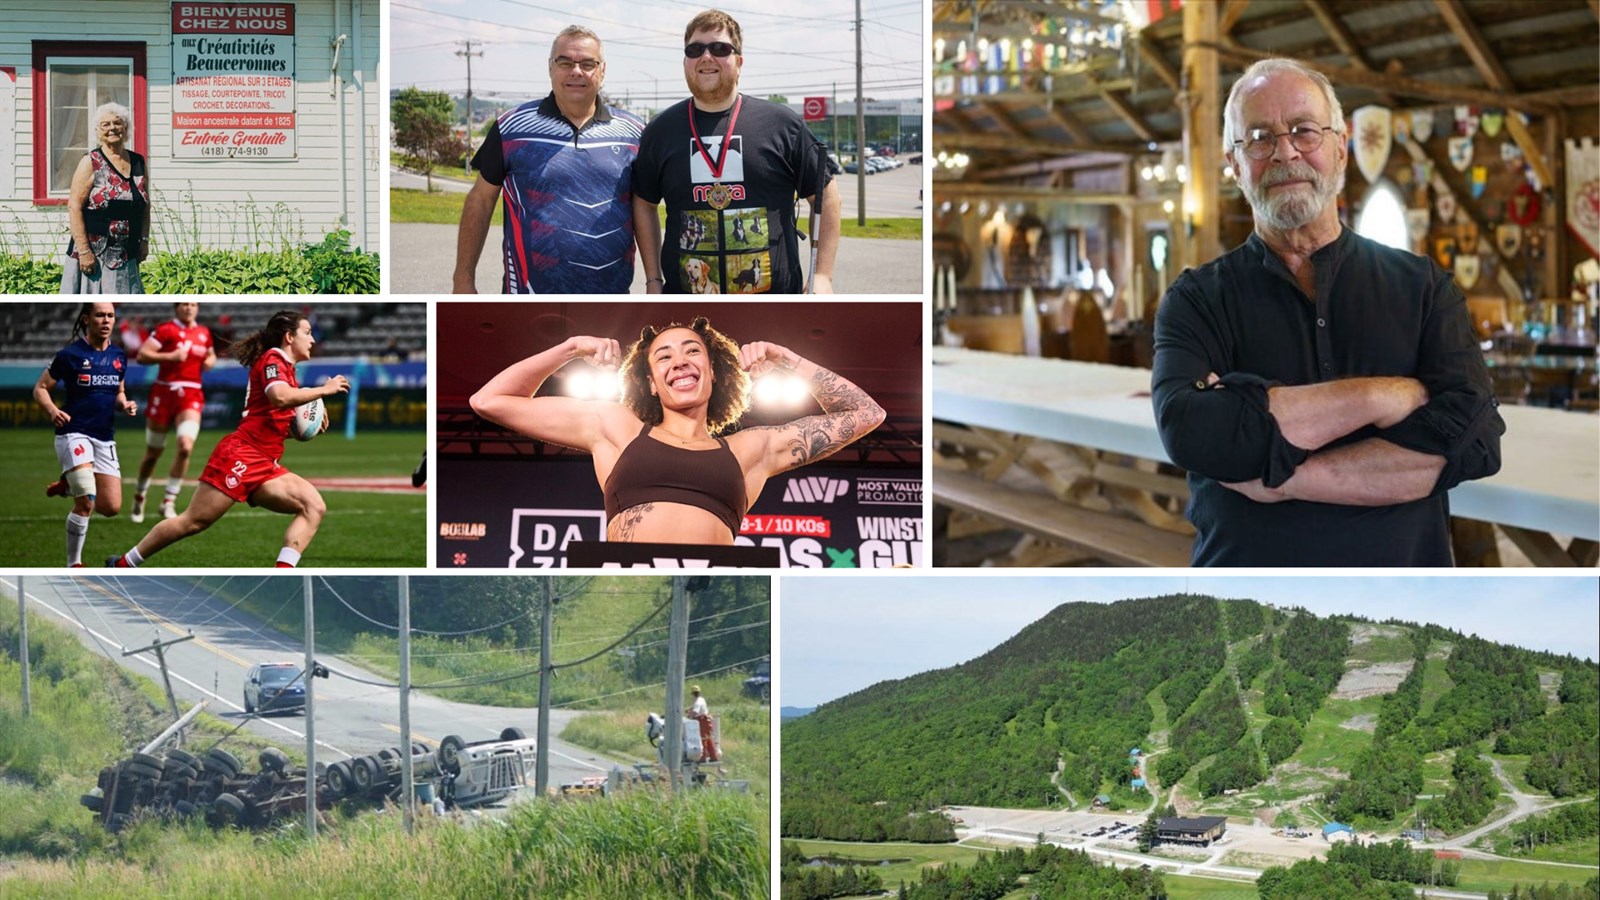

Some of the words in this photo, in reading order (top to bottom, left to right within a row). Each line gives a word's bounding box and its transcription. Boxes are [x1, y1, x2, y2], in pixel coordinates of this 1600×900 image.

[181, 6, 286, 17] BIENVENUE
[180, 19, 230, 29] CHEZ
[235, 19, 287, 30] NOUS
[182, 38, 196, 48] aux
[197, 37, 275, 55] Créativités
[186, 54, 286, 71] Beauceronnes
[176, 76, 212, 86] ARTISANAT
[213, 74, 246, 86] RÉGIONAL
[248, 77, 260, 87] SUR
[262, 77, 266, 87] 3
[267, 74, 291, 87] ÉTAGES
[182, 90, 210, 99] TISSAGE,
[263, 90, 286, 99] TRICOT,
[176, 116, 201, 125] Maison
[203, 116, 239, 126] ancestrale
[241, 116, 262, 126] datant
[264, 117, 273, 126] de
[275, 117, 291, 126] 1825
[181, 131, 230, 145] Entrée
[232, 131, 287, 146] Gratuite
[201, 146, 224, 156] (418)
[227, 146, 268, 156] 774-9130
[692, 184, 746, 203] ma
[231, 460, 248, 477] 22
[783, 477, 849, 504] MVP
[857, 481, 889, 491] MOST
[892, 482, 923, 492] VALU
[775, 519, 793, 533] 10
[796, 519, 826, 534] KOs
[534, 523, 583, 551] DA
